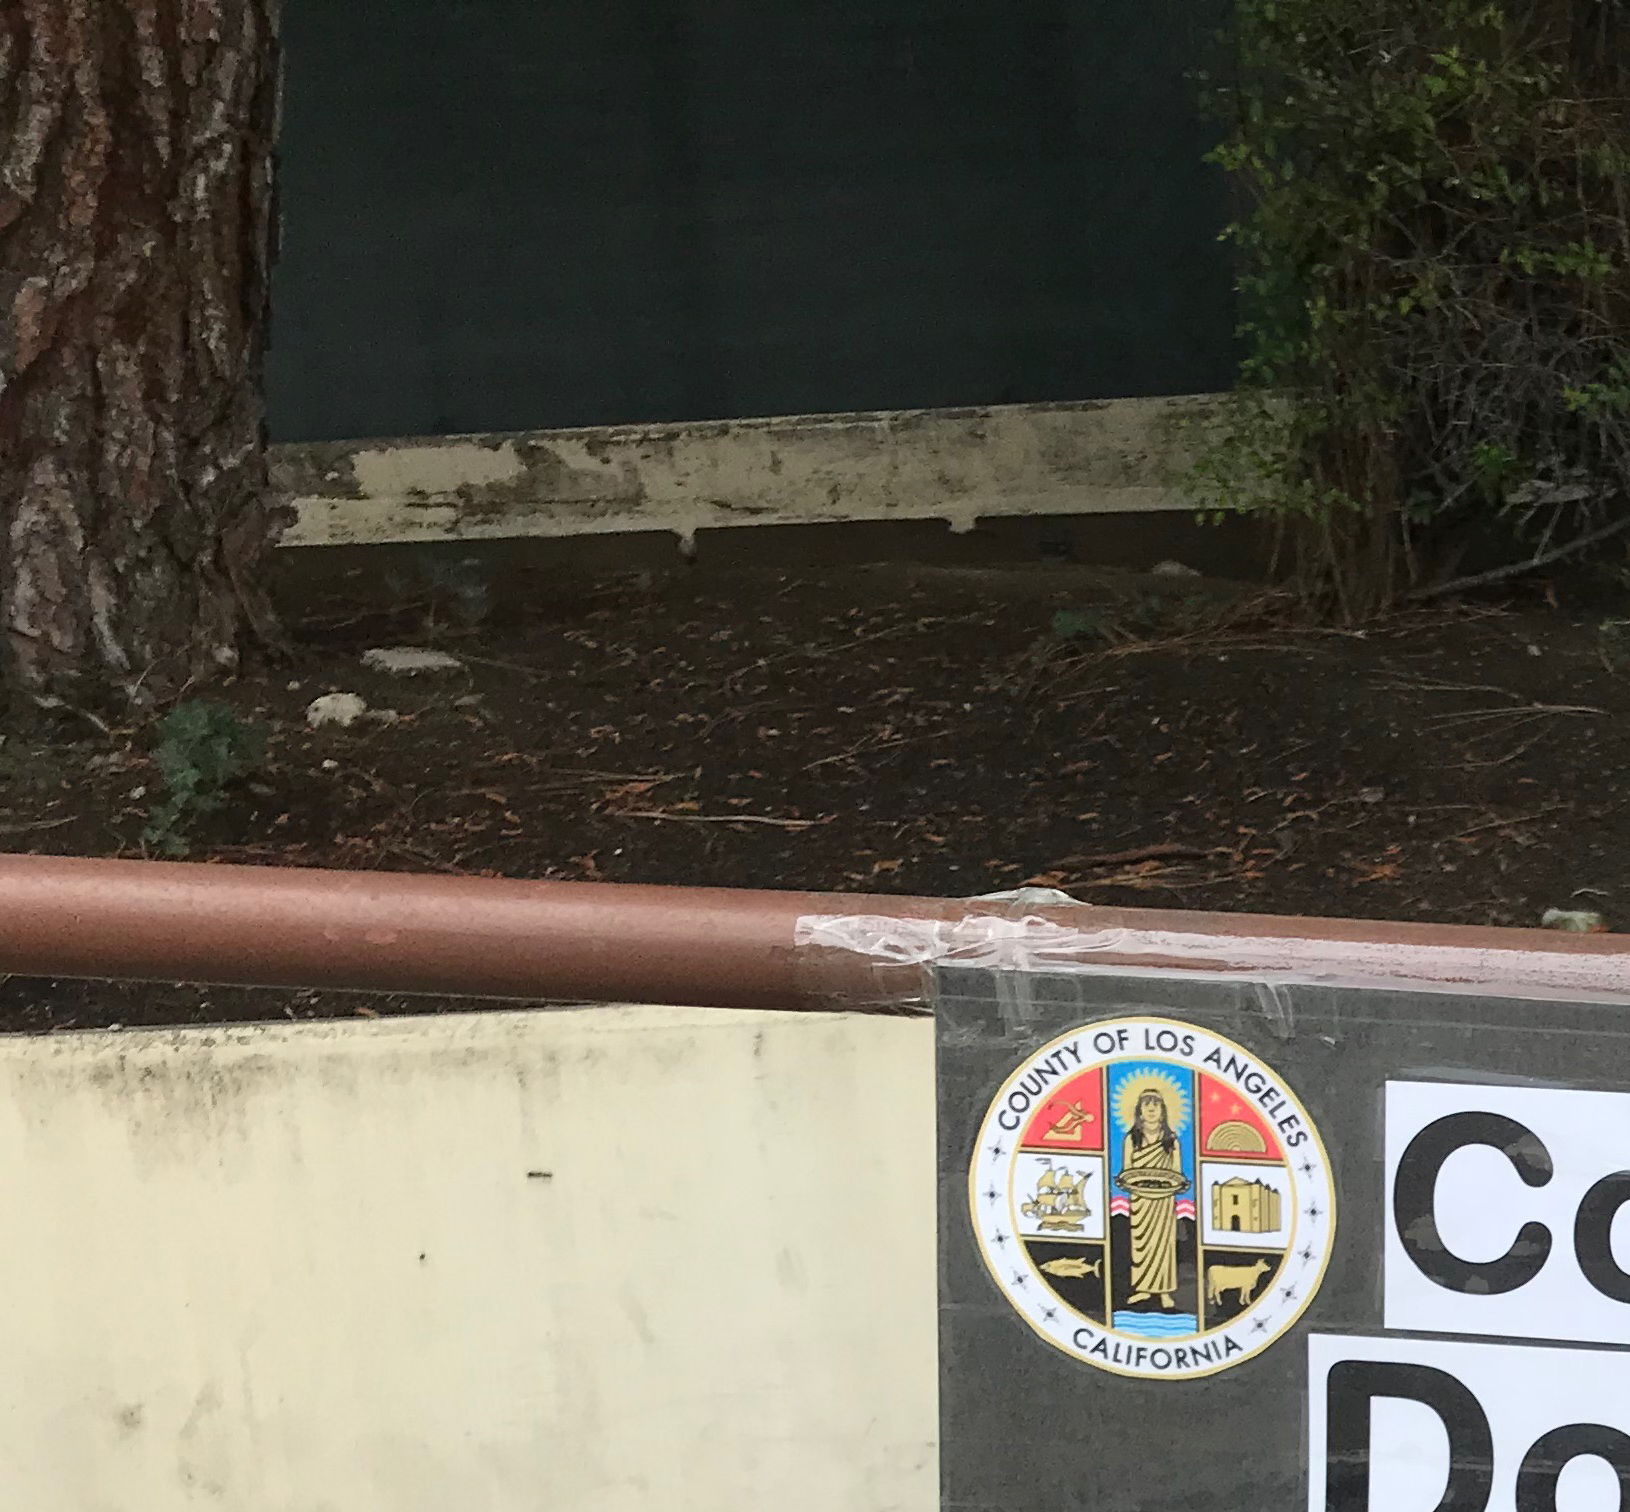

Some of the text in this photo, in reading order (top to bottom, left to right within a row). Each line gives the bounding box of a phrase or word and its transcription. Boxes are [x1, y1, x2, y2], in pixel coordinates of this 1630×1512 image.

[997, 1028, 1308, 1148] COUNTY OF LOS ANGELES
[1073, 1328, 1244, 1370] CALIFORNIA
